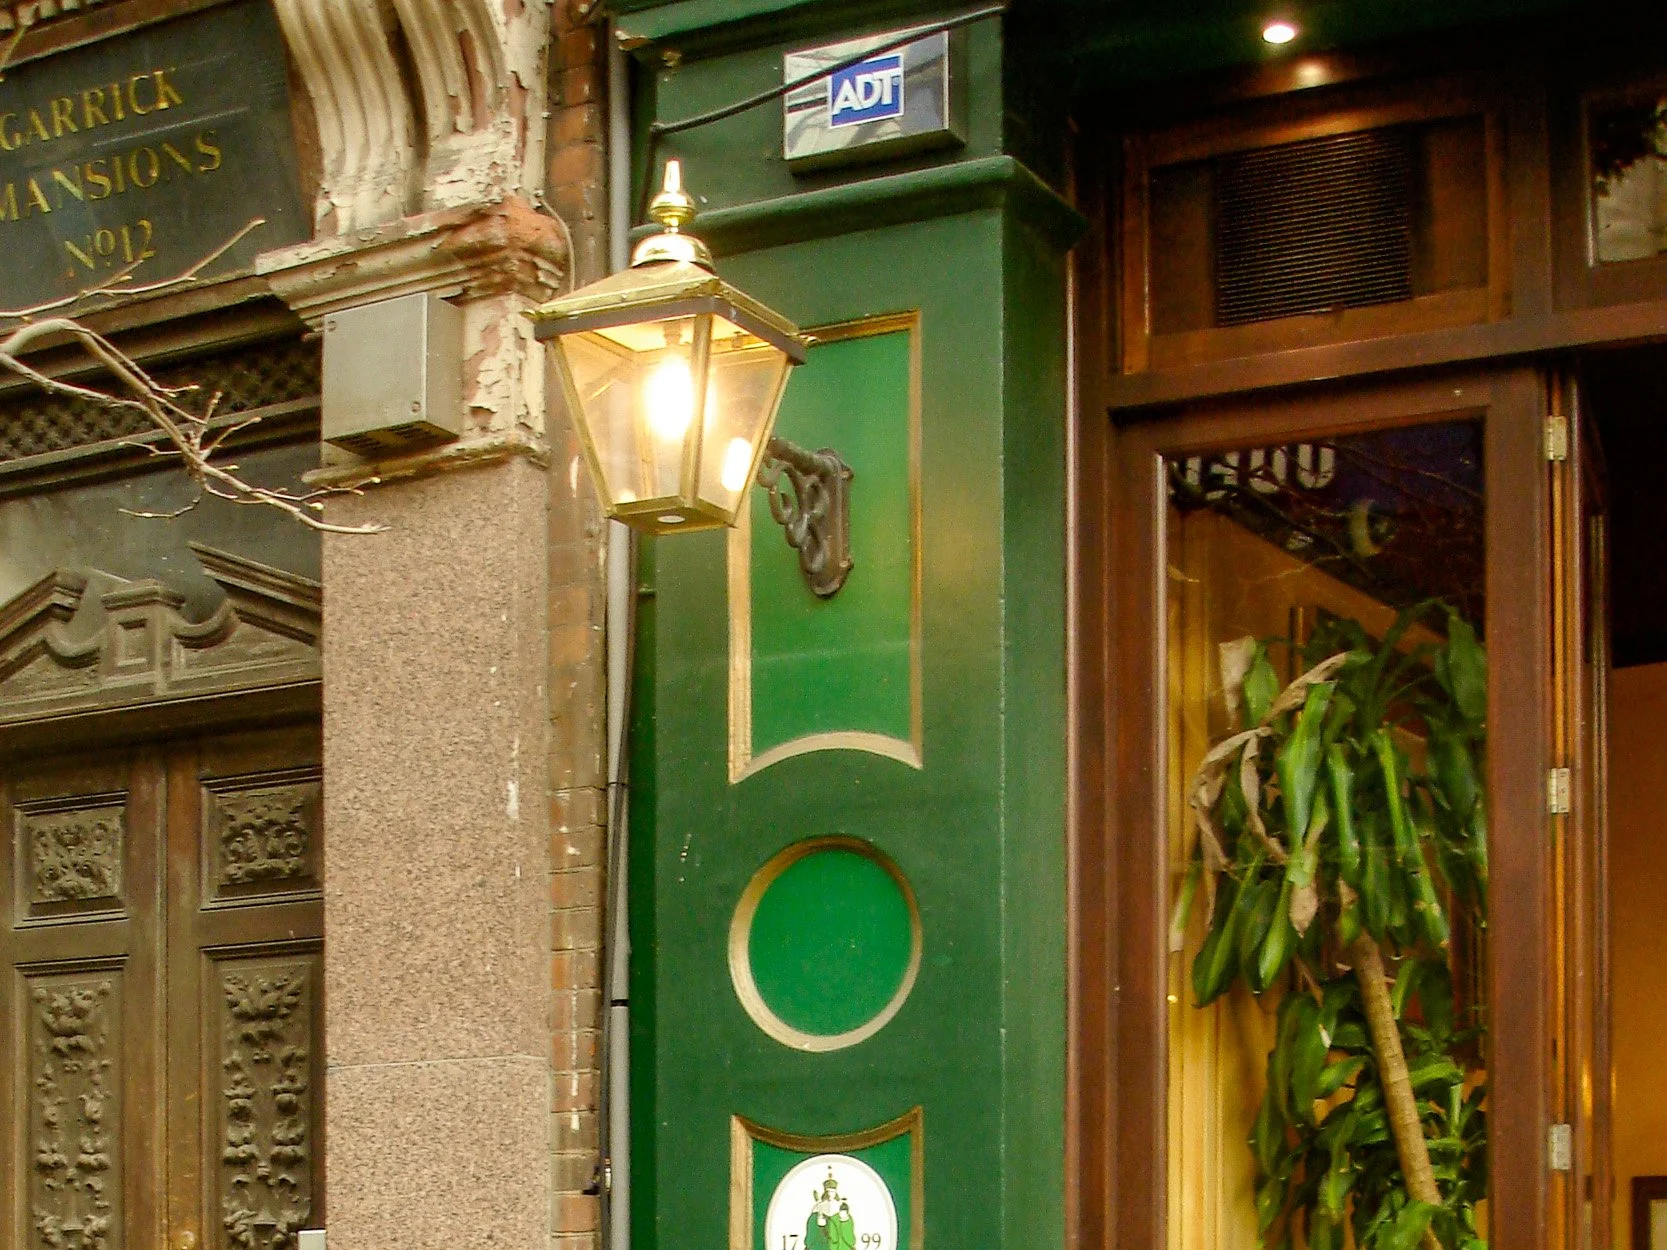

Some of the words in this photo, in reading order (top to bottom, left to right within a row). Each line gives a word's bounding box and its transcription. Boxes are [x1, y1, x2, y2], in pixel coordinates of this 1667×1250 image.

[0, 68, 183, 151] GARRICK
[832, 67, 901, 115] ADT
[861, 1233, 882, 1250] 99
